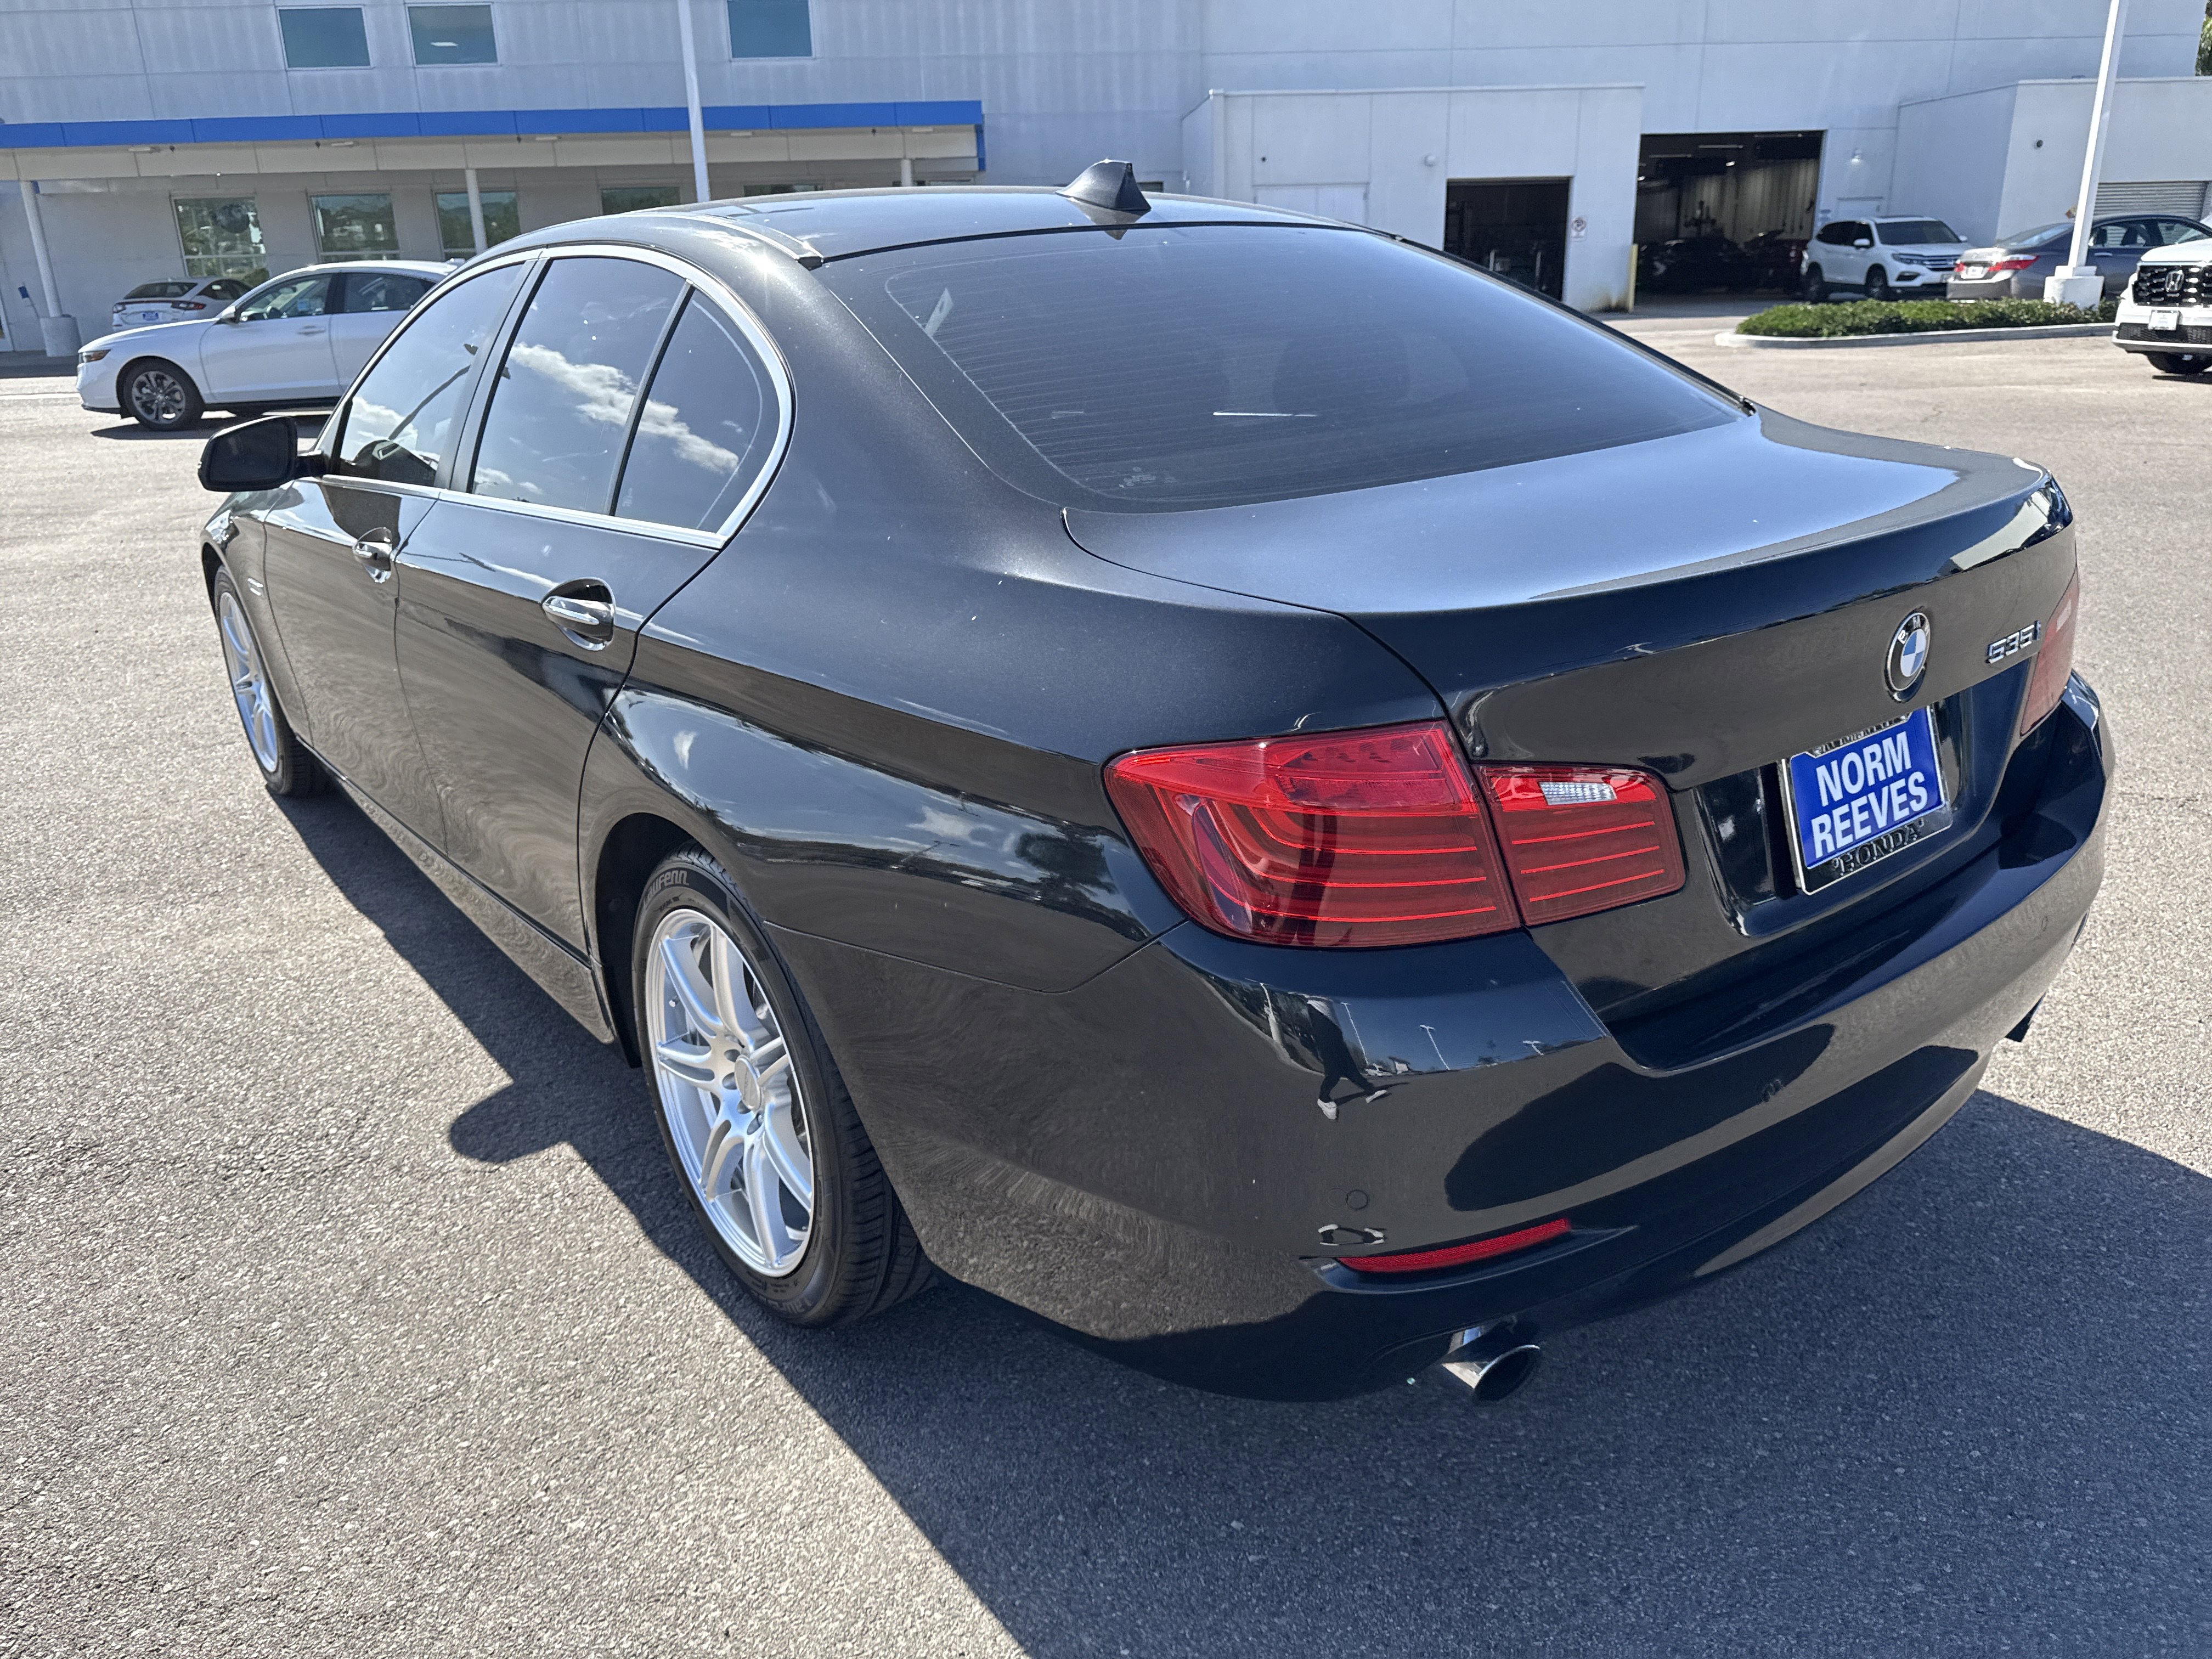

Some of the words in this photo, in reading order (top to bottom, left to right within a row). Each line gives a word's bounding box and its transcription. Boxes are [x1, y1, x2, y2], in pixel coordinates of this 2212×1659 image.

[1986, 620, 2041, 664] 535i
[1815, 731, 1912, 807] NORM
[1811, 771, 1928, 859] REEVES
[1838, 824, 1919, 876] HONDA
